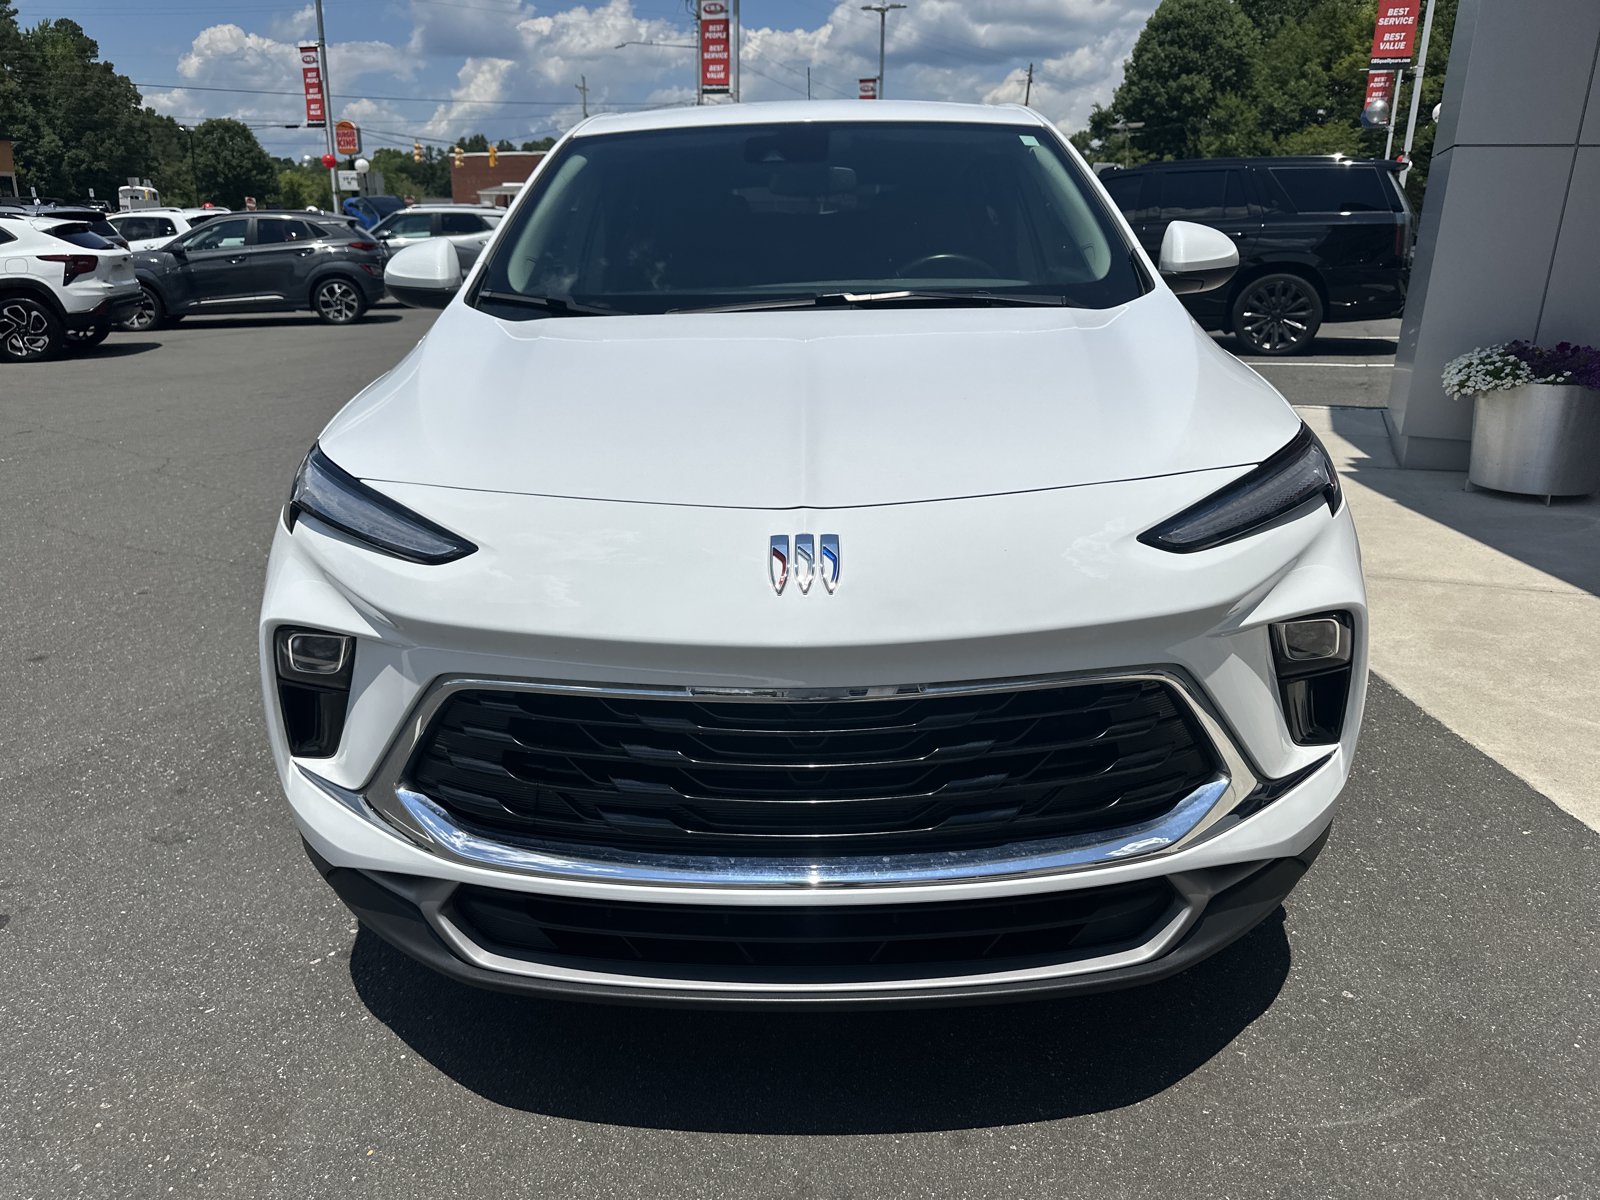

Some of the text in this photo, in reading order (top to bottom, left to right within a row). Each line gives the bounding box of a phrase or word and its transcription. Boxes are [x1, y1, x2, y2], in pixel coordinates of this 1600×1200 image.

[1387, 8, 1409, 16] BEST
[1378, 17, 1414, 25] SERVICE
[1384, 33, 1406, 41] BEST
[1380, 42, 1406, 50] VALUE
[337, 138, 357, 147] KING
